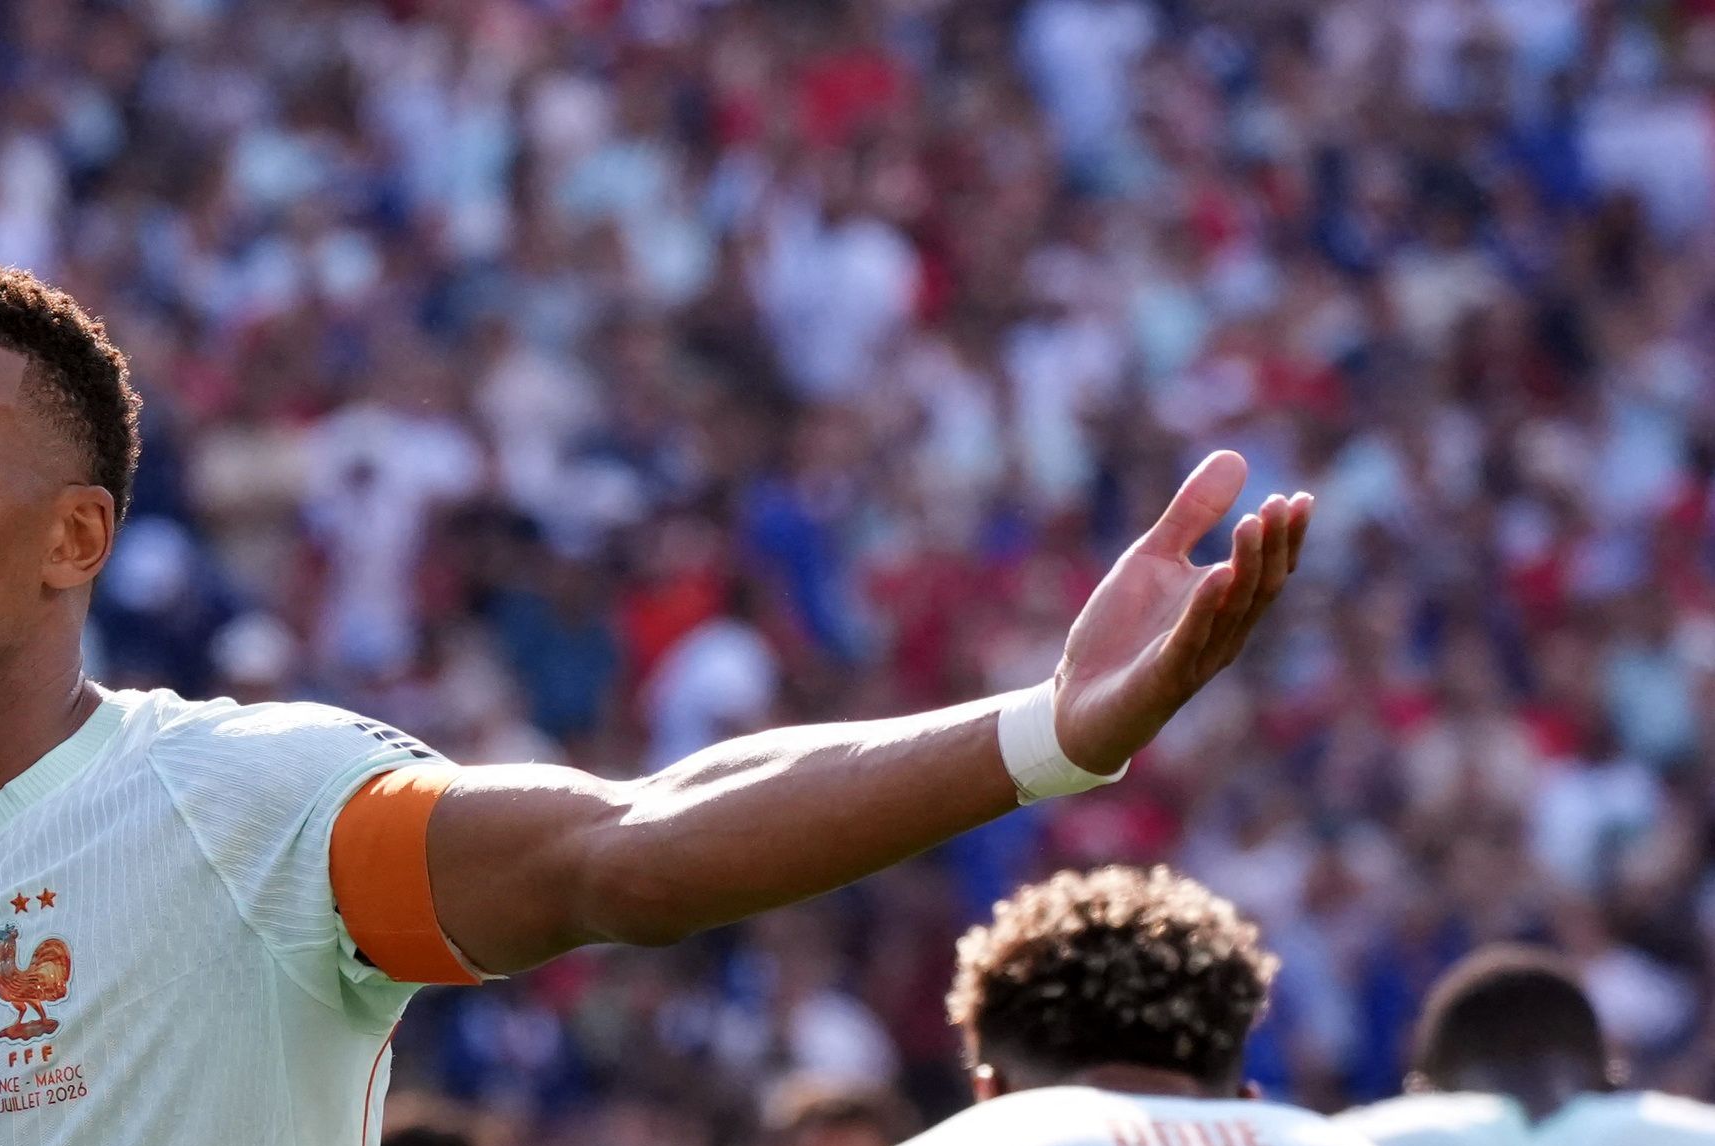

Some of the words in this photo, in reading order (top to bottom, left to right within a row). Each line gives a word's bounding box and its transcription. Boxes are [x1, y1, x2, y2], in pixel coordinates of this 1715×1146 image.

[34, 1064, 83, 1088] MAROC
[0, 1091, 41, 1114] JUILLET
[46, 1081, 88, 1105] 2026
